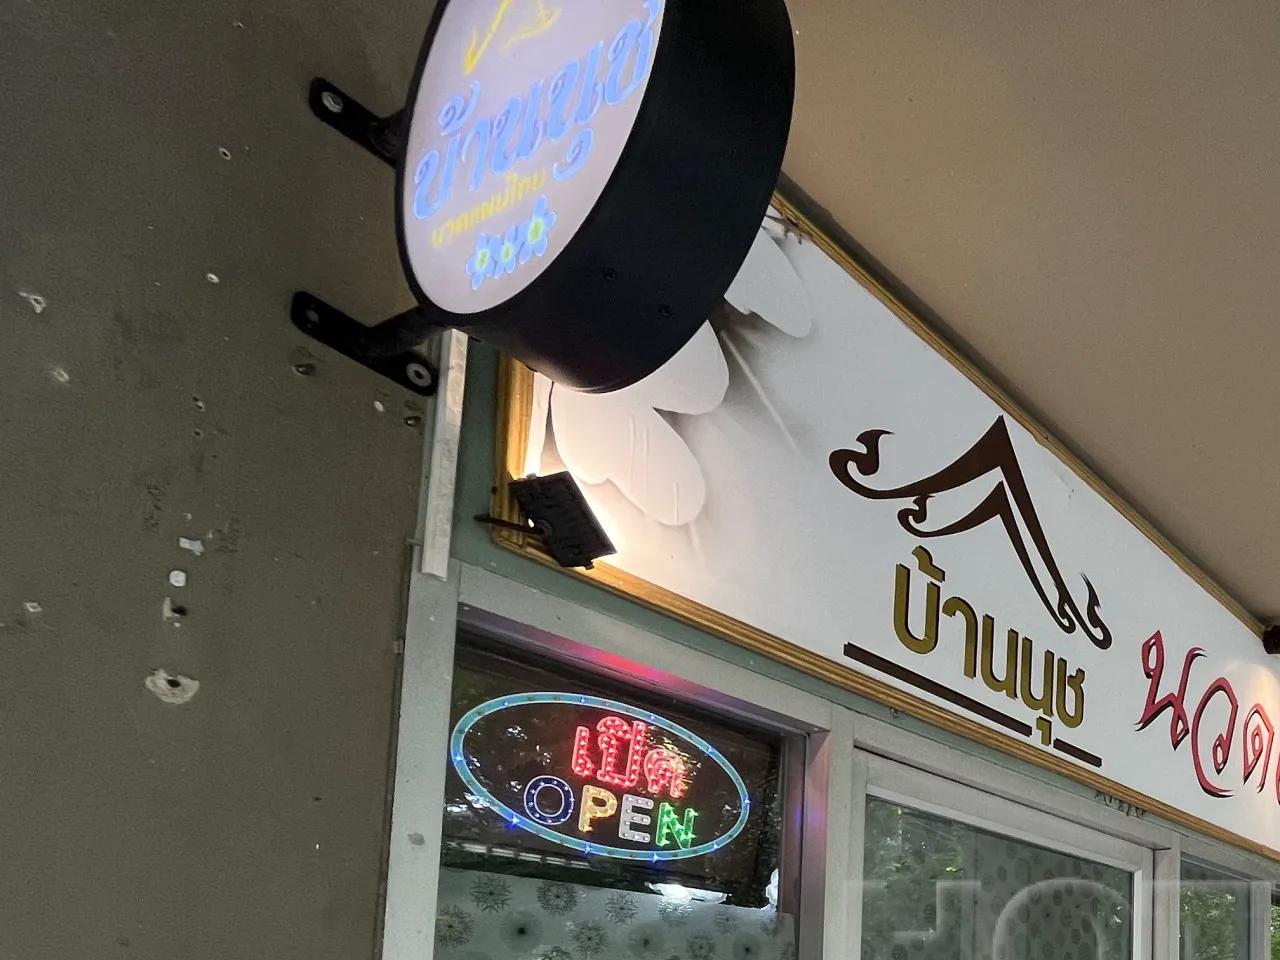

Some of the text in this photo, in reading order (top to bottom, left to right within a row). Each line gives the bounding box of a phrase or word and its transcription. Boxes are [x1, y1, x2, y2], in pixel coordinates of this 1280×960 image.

[893, 545, 1086, 747] บ้านนุช
[571, 716, 685, 798] เปิด
[523, 775, 699, 850] OPEN
